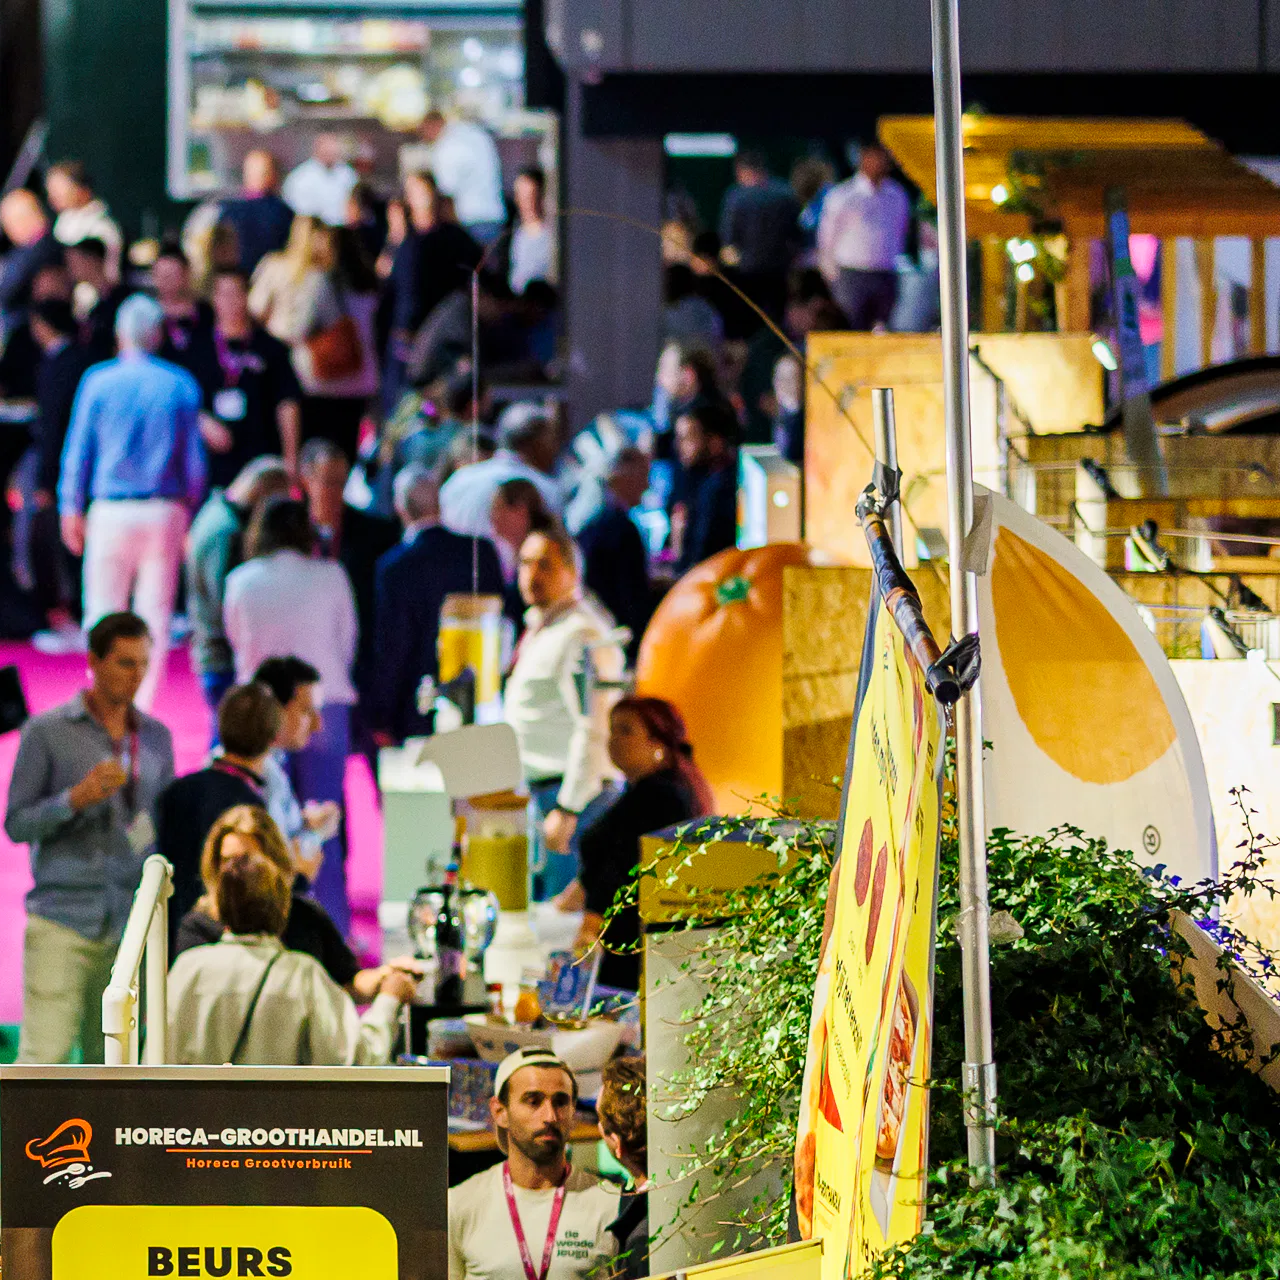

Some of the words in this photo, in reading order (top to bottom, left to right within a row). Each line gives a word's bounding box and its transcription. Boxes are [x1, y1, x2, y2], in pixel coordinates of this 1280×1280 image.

[115, 1127, 423, 1148] HORECA-GROOTHANDEL.NL
[186, 1157, 240, 1169] Horeca
[245, 1156, 353, 1170] Grootverbruik
[147, 1246, 293, 1278] BEURS
